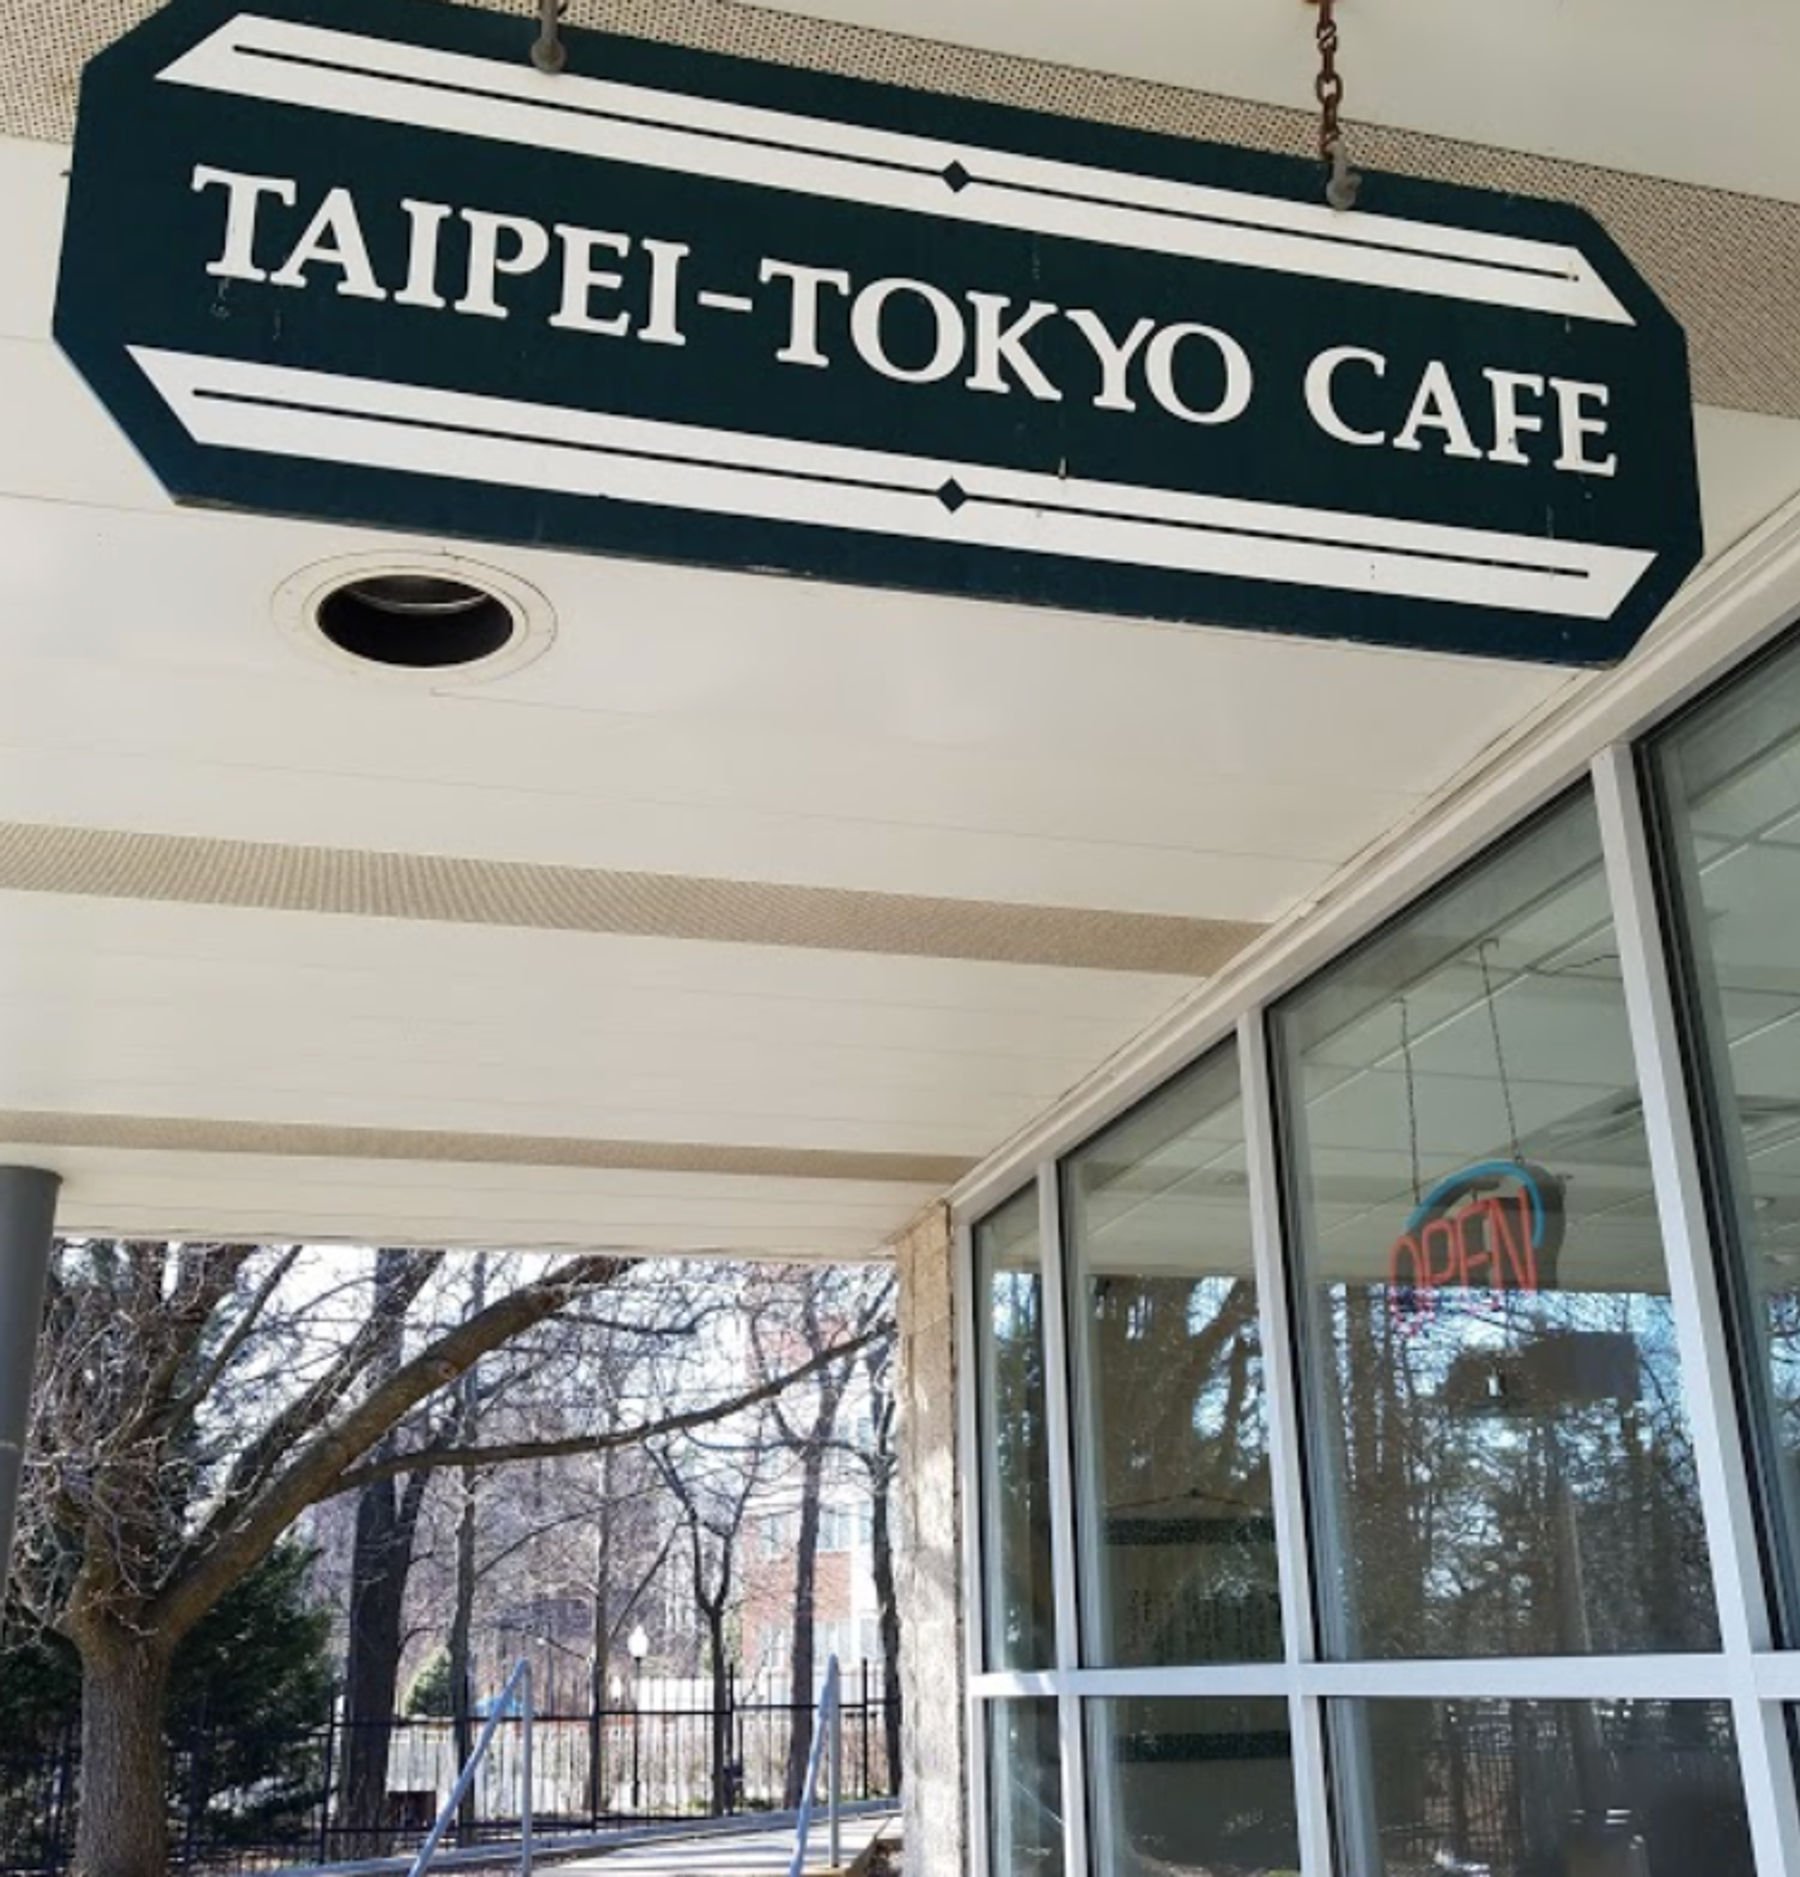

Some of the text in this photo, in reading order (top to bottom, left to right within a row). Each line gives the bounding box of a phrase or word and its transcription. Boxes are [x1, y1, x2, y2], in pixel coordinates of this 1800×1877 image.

[192, 164, 1616, 476] TAIPEI-TOKYO CAFE
[1388, 1184, 1538, 1334] OPEN
